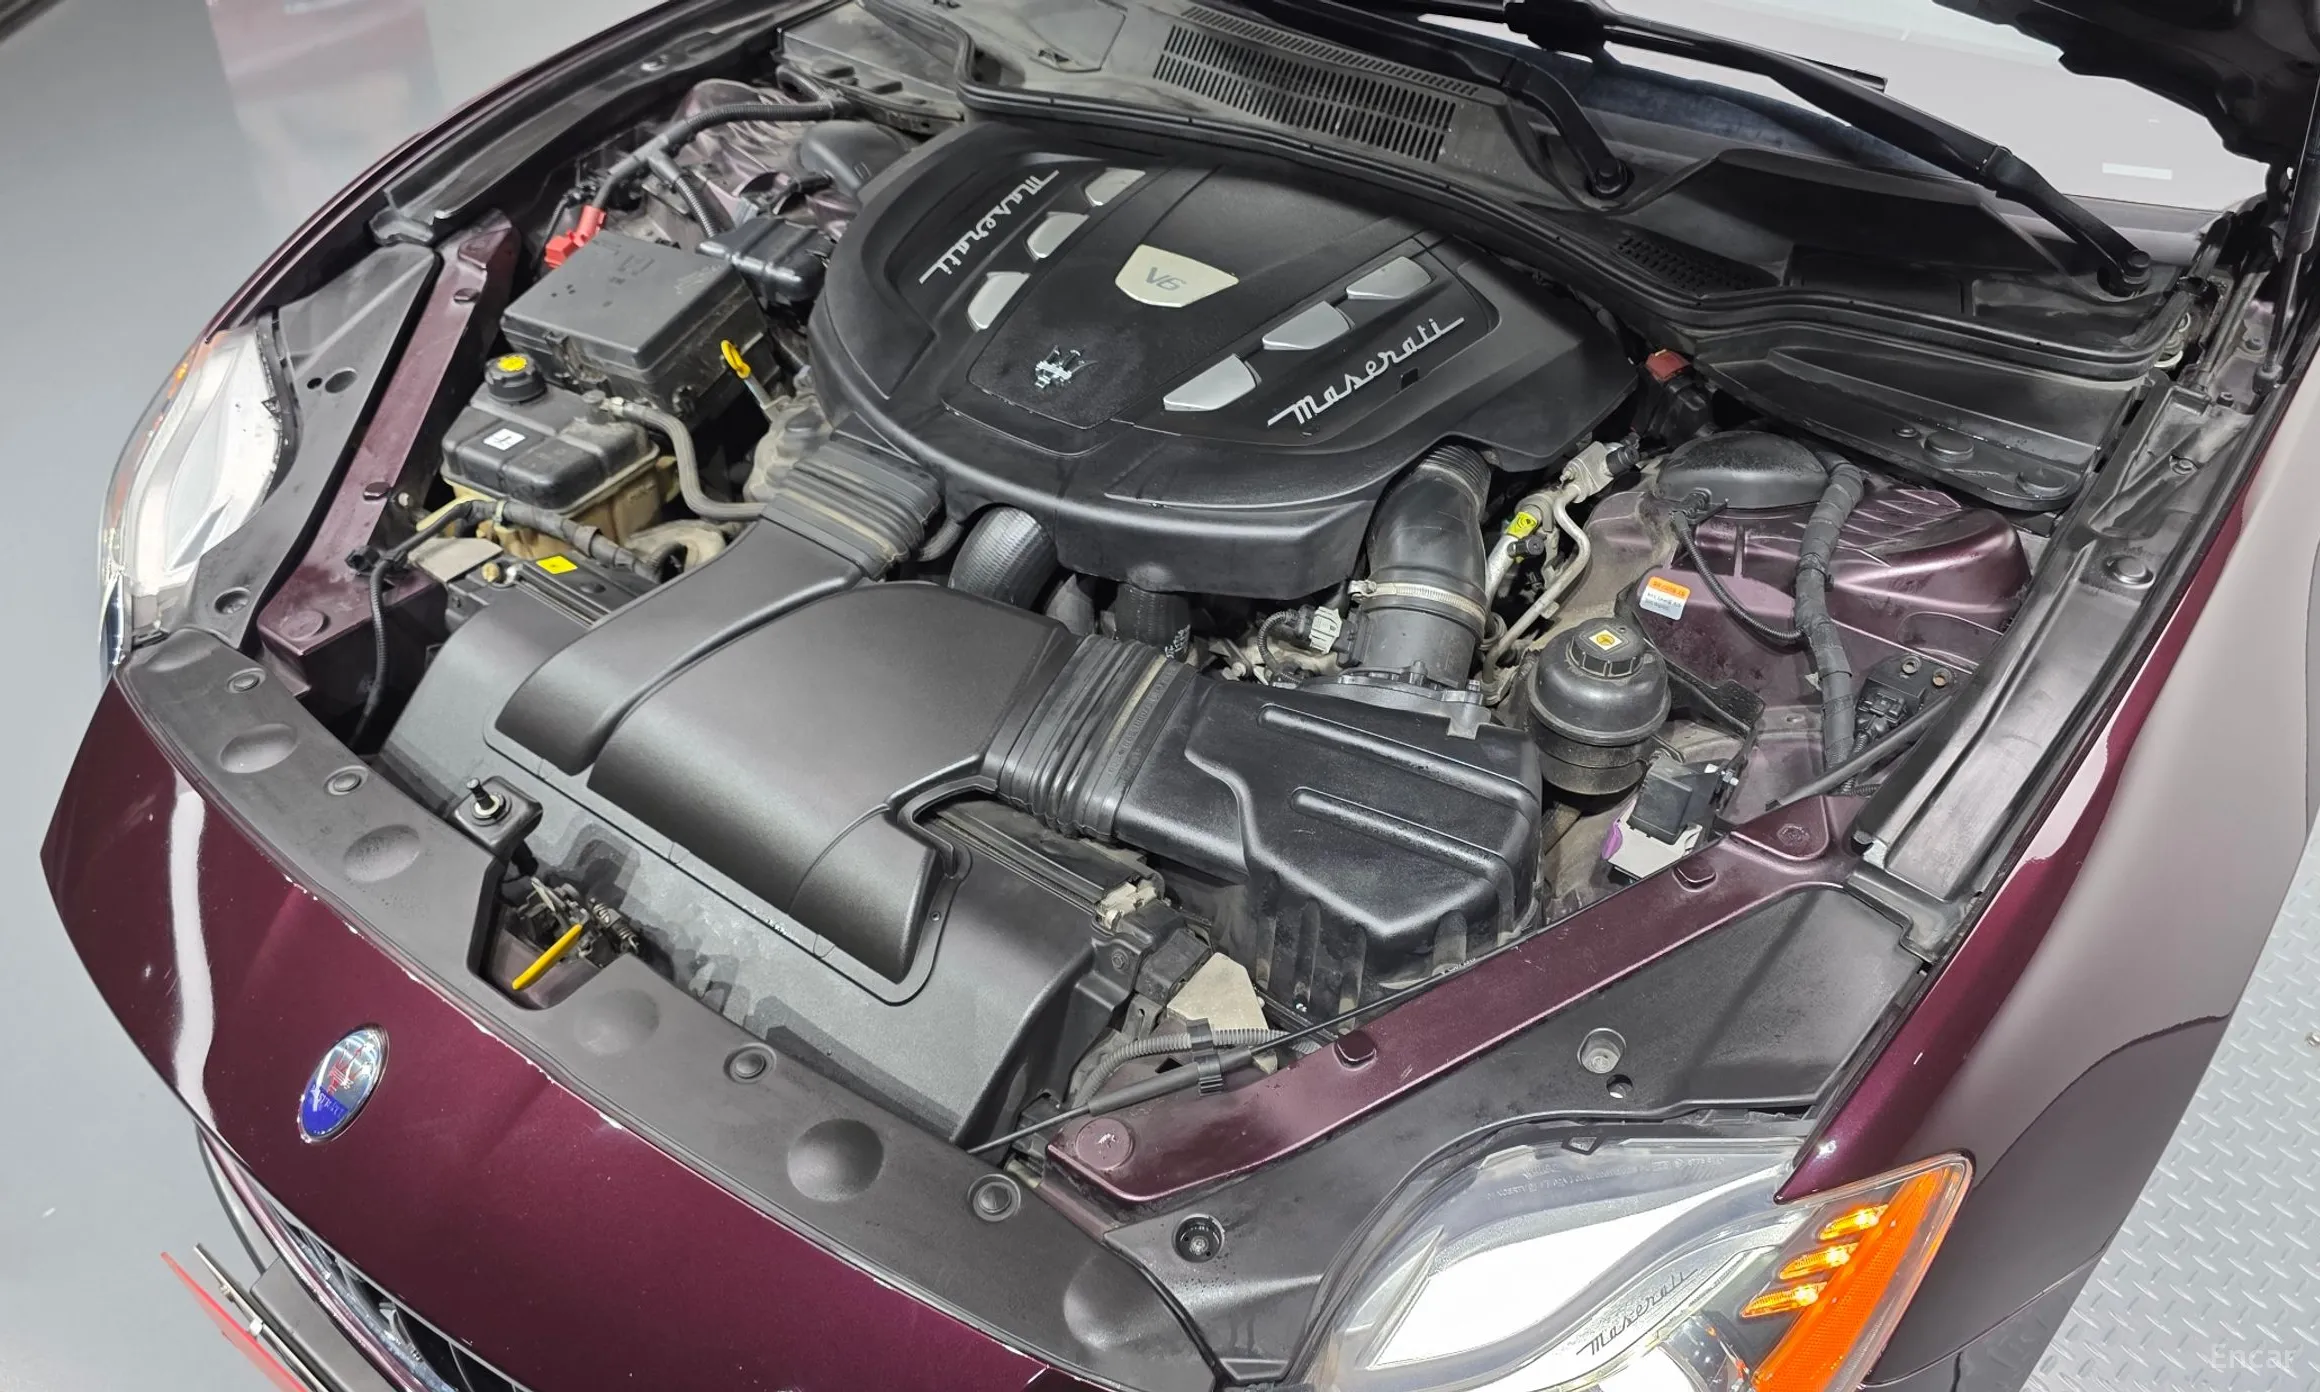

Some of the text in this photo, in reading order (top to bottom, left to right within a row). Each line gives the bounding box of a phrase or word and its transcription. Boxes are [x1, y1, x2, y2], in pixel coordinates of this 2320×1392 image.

[919, 169, 1060, 284] Maserati
[1145, 266, 1187, 291] V6
[1267, 318, 1465, 427] Maserati
[1576, 1268, 1698, 1356] Maserati
